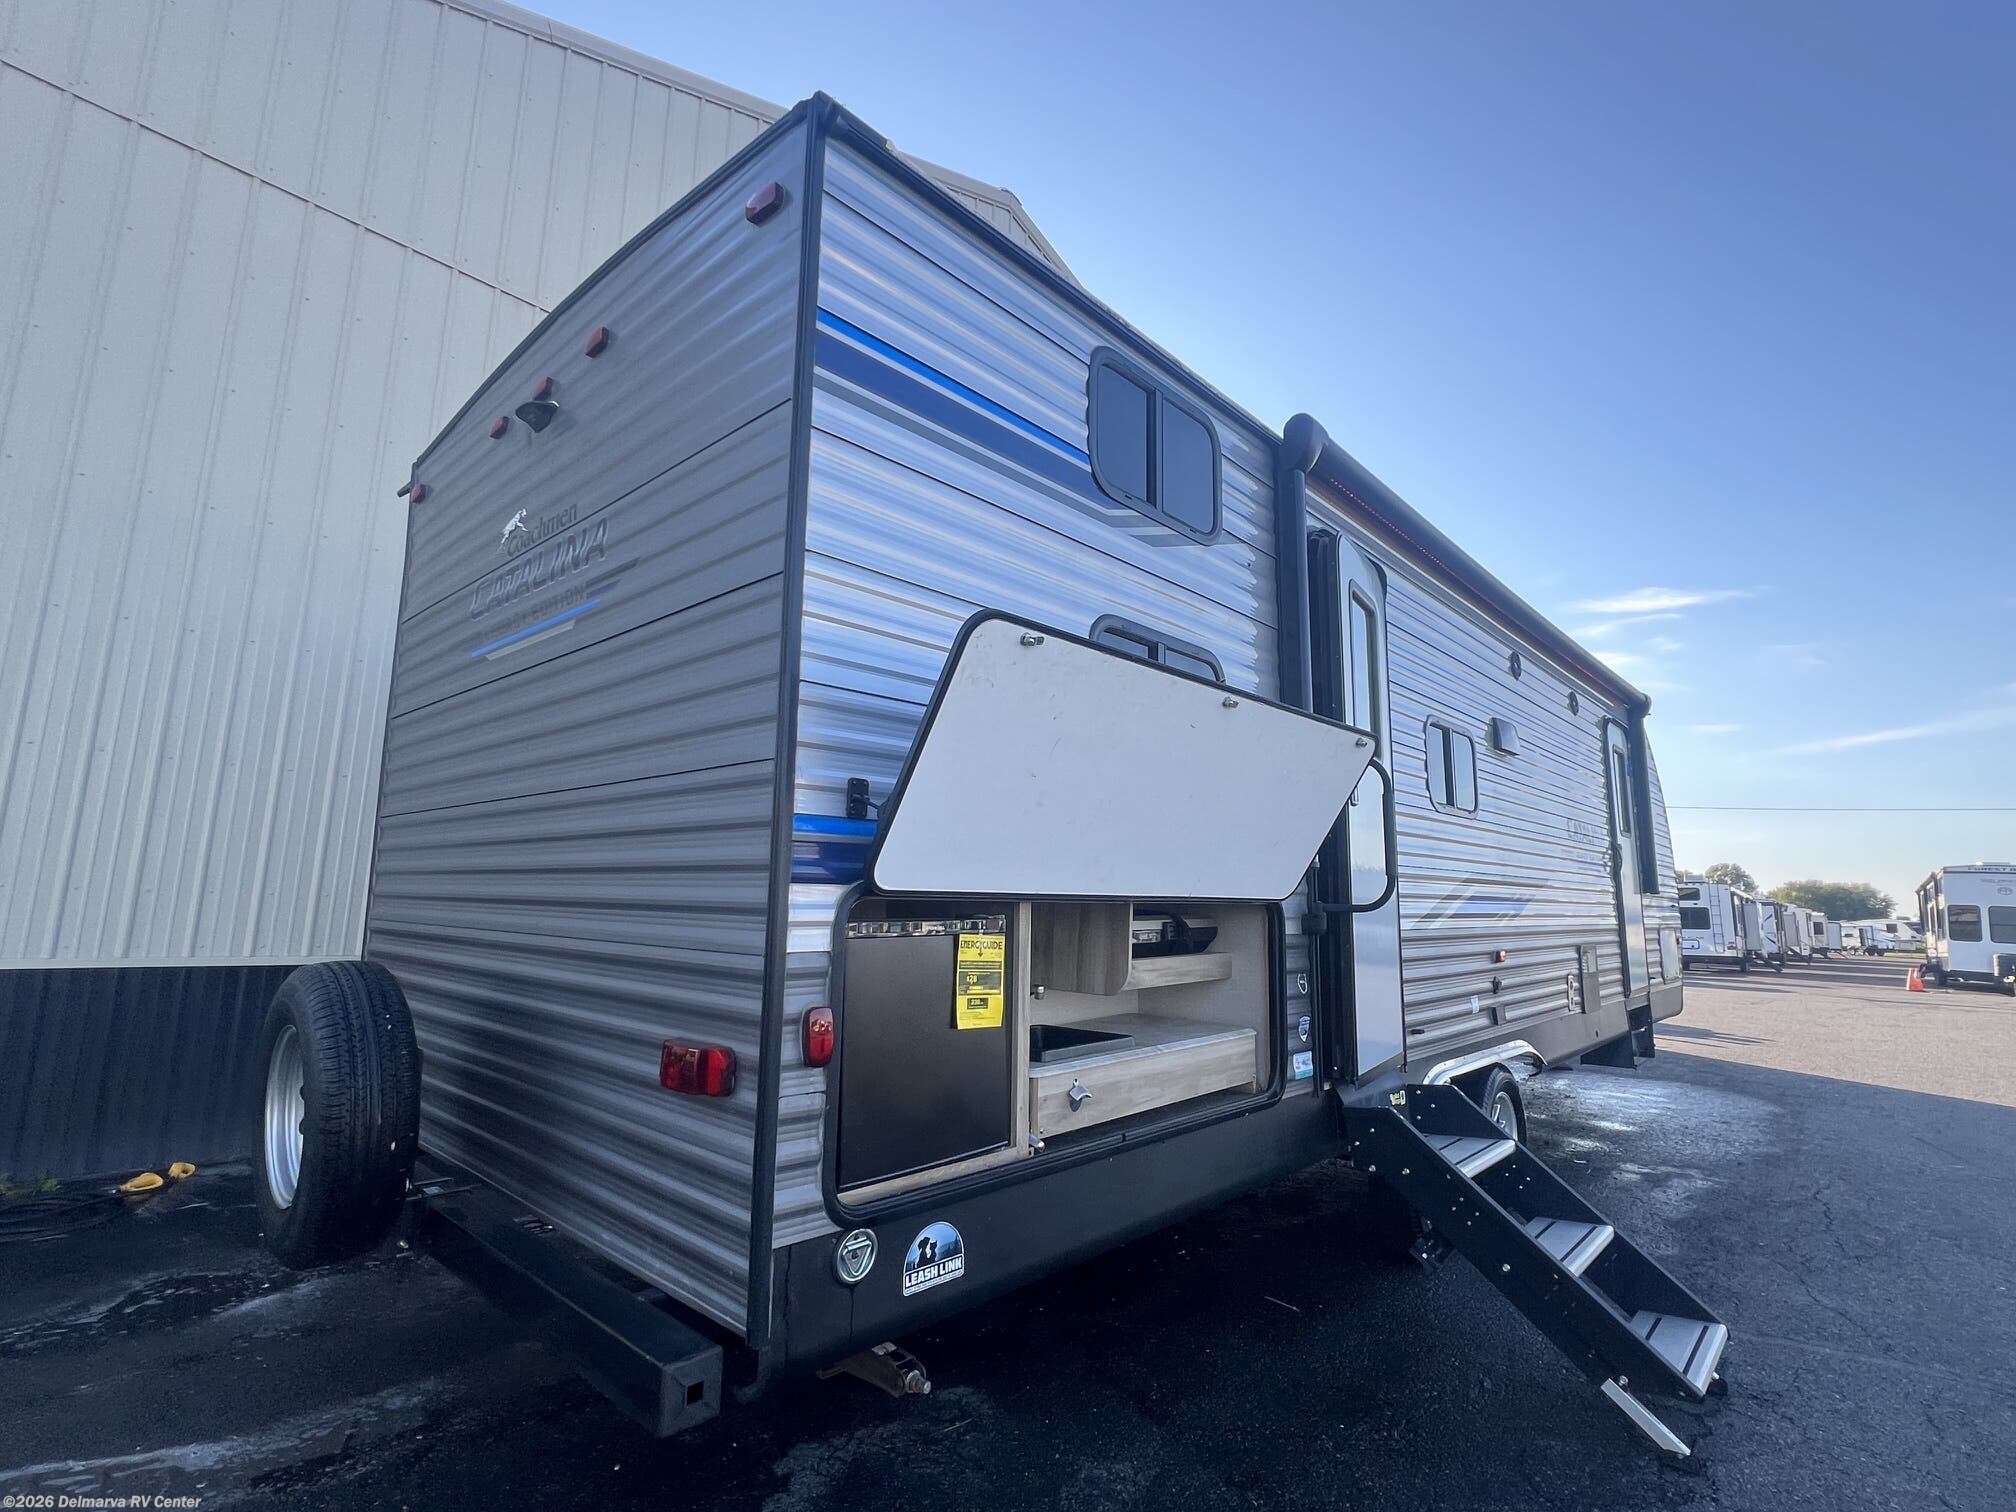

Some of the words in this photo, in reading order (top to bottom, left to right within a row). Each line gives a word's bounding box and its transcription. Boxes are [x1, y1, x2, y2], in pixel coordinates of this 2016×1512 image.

[470, 516, 608, 622] CATALINA
[905, 1265, 939, 1288] LEASH
[939, 1257, 962, 1276] LINK
